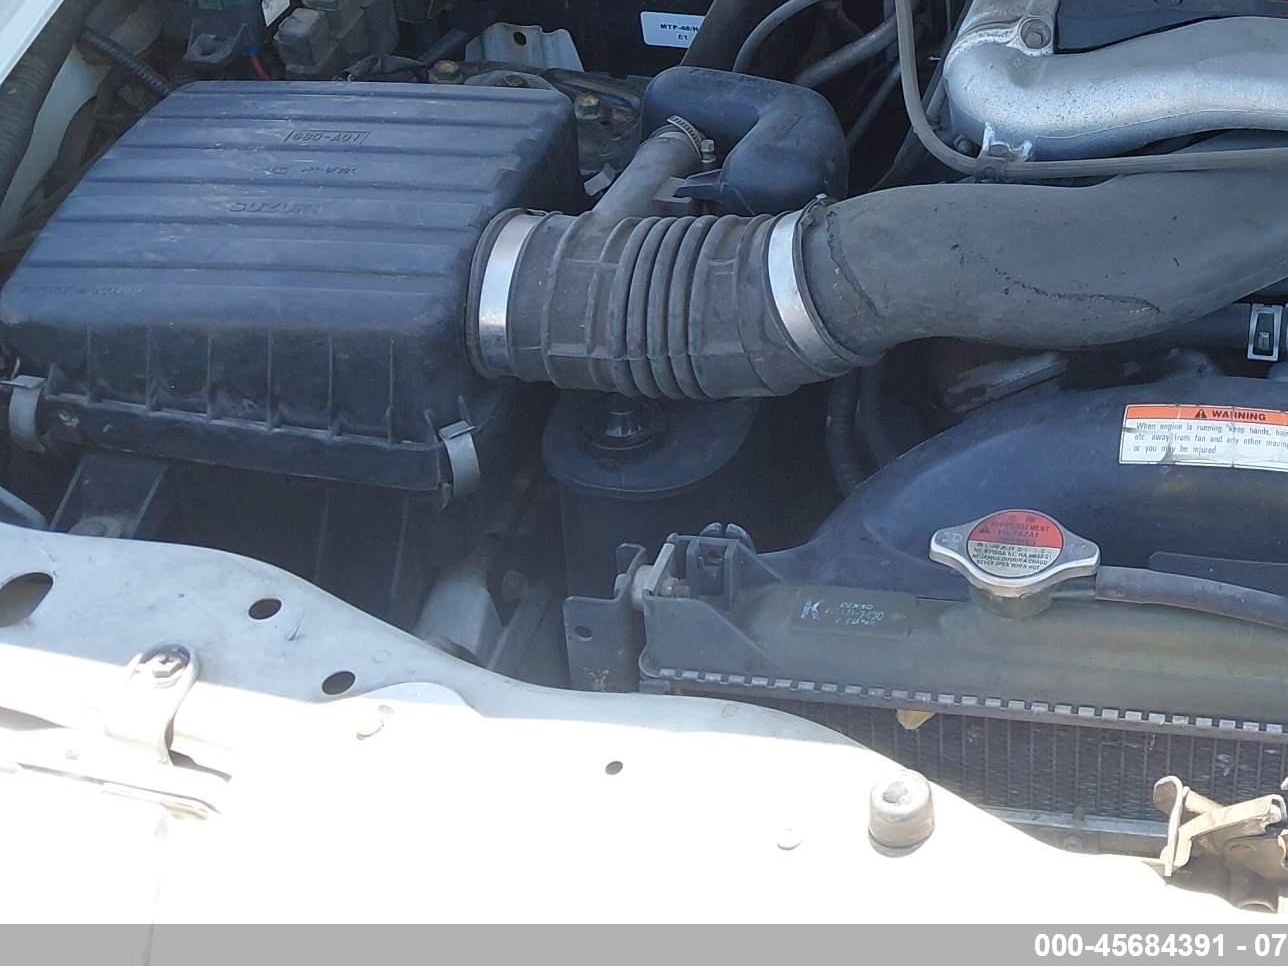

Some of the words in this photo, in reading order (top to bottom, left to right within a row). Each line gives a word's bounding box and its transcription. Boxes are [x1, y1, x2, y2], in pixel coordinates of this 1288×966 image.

[1211, 409, 1266, 421] WARNING
[1136, 421, 1156, 430] When
[1160, 423, 1182, 432] engine
[1151, 434, 1169, 442] away
[1194, 434, 1206, 442] fan
[1209, 435, 1223, 443] and
[1144, 445, 1157, 454] you
